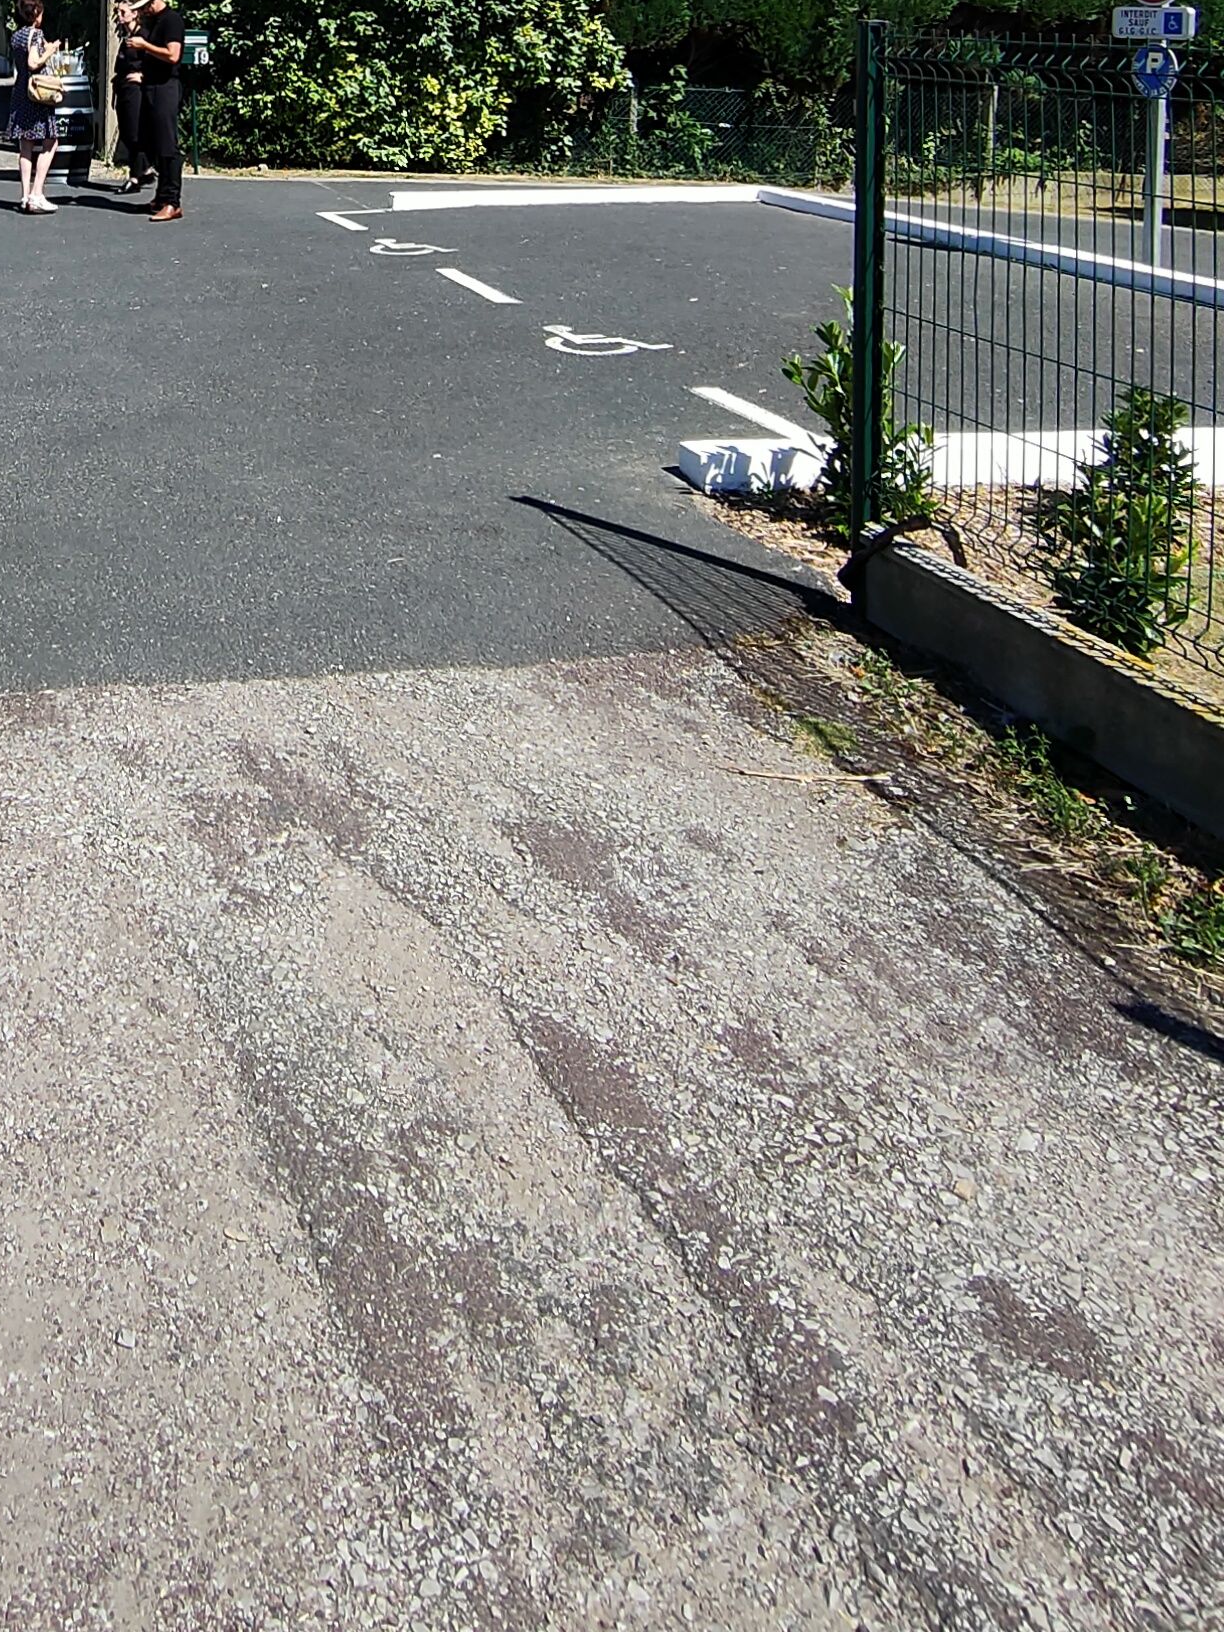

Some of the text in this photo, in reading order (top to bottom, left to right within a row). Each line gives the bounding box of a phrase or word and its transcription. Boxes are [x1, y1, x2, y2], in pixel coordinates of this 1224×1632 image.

[1120, 10, 1158, 19] INTERDIT
[1128, 18, 1150, 27] SAUF
[193, 51, 209, 65] 19
